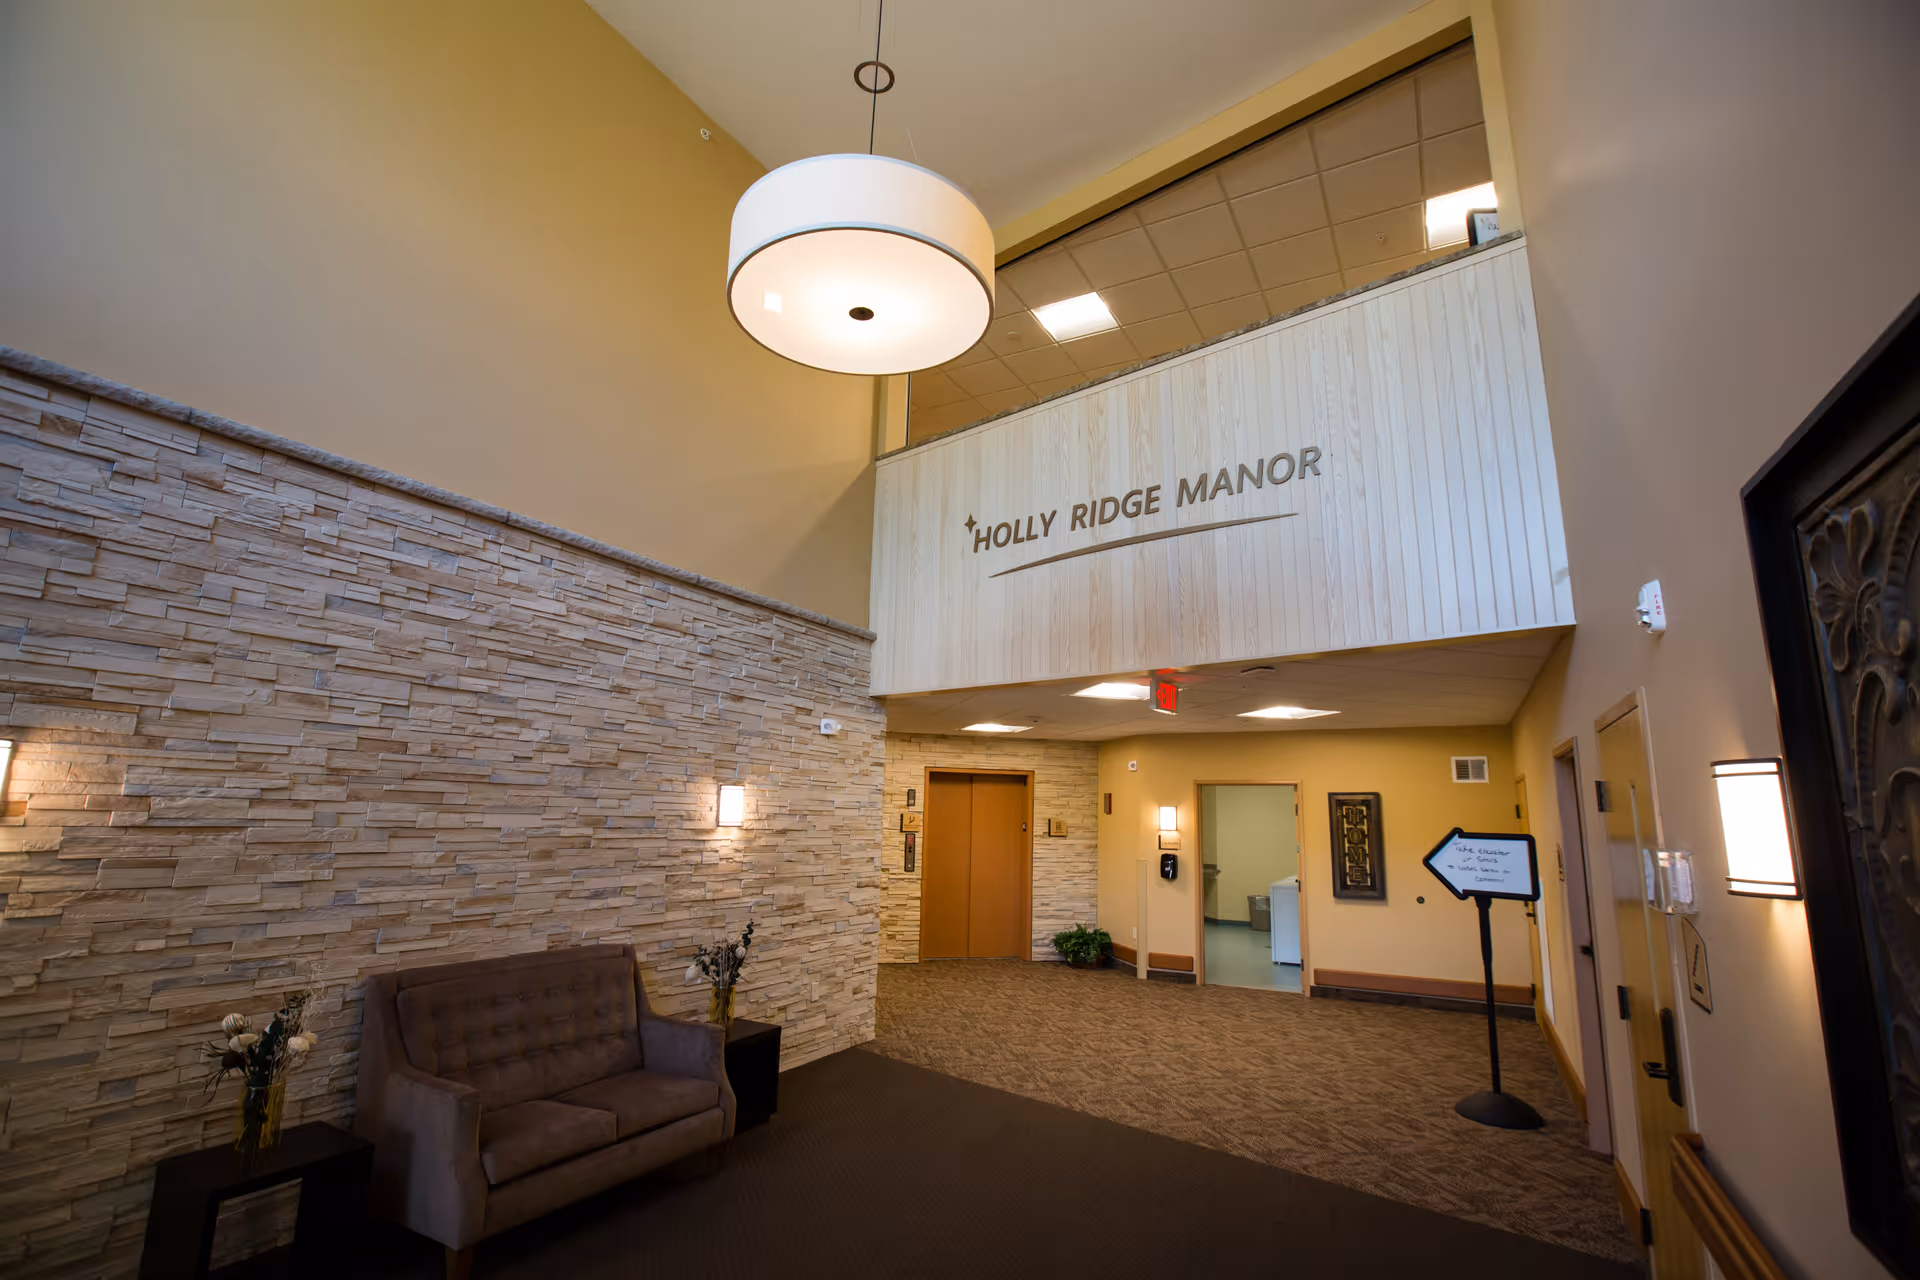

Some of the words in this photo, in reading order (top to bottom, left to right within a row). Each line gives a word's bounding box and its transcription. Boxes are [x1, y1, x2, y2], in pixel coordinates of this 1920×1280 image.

[973, 510, 1057, 553] HOLLY
[1070, 484, 1161, 531] RIDGE
[1176, 446, 1321, 507] MANOR
[1160, 683, 1177, 711] EXIT
